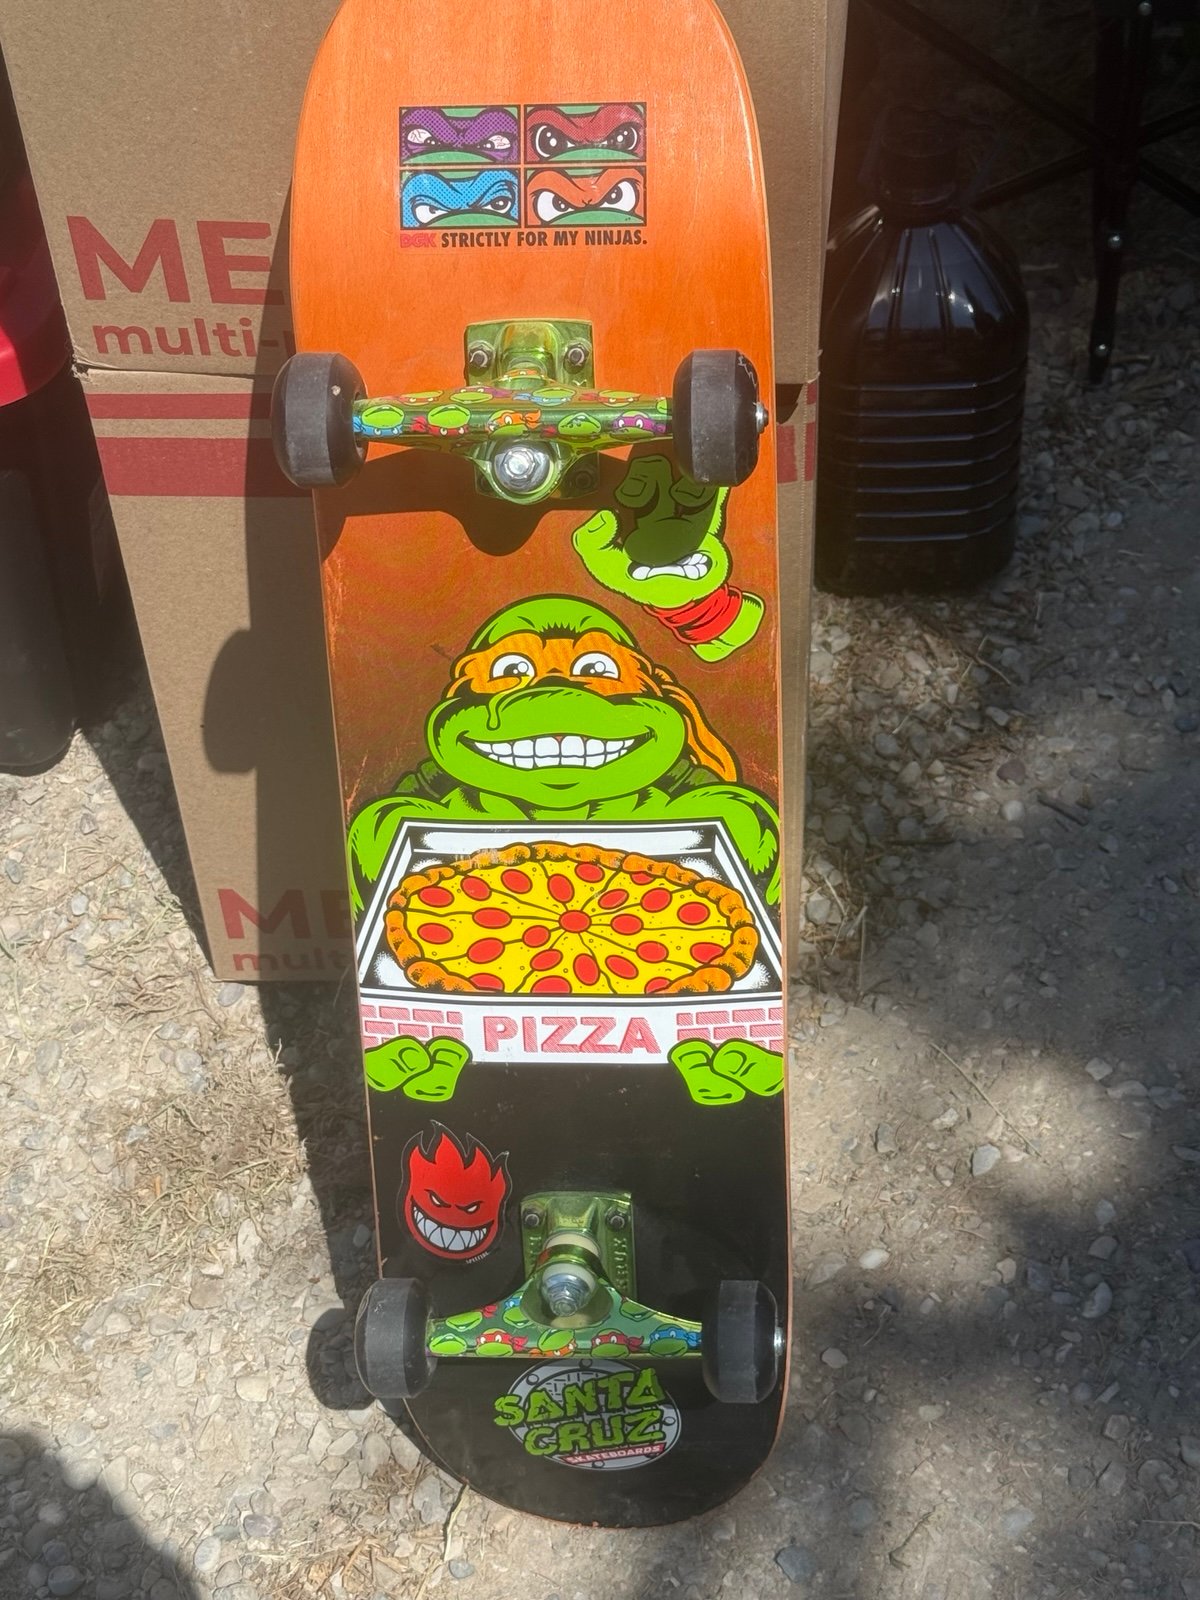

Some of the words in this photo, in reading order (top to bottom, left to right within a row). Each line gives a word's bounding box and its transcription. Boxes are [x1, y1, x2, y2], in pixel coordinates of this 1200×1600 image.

[441, 231, 511, 248] STRICTLY
[517, 231, 548, 247] FOR
[553, 230, 578, 246] MY
[584, 229, 648, 245] NINJAS.
[483, 1016, 662, 1054] PIZZA
[493, 1367, 666, 1427] SANTA
[524, 1408, 667, 1456] CRUZ
[565, 1445, 661, 1465] SKATEBOARDS
